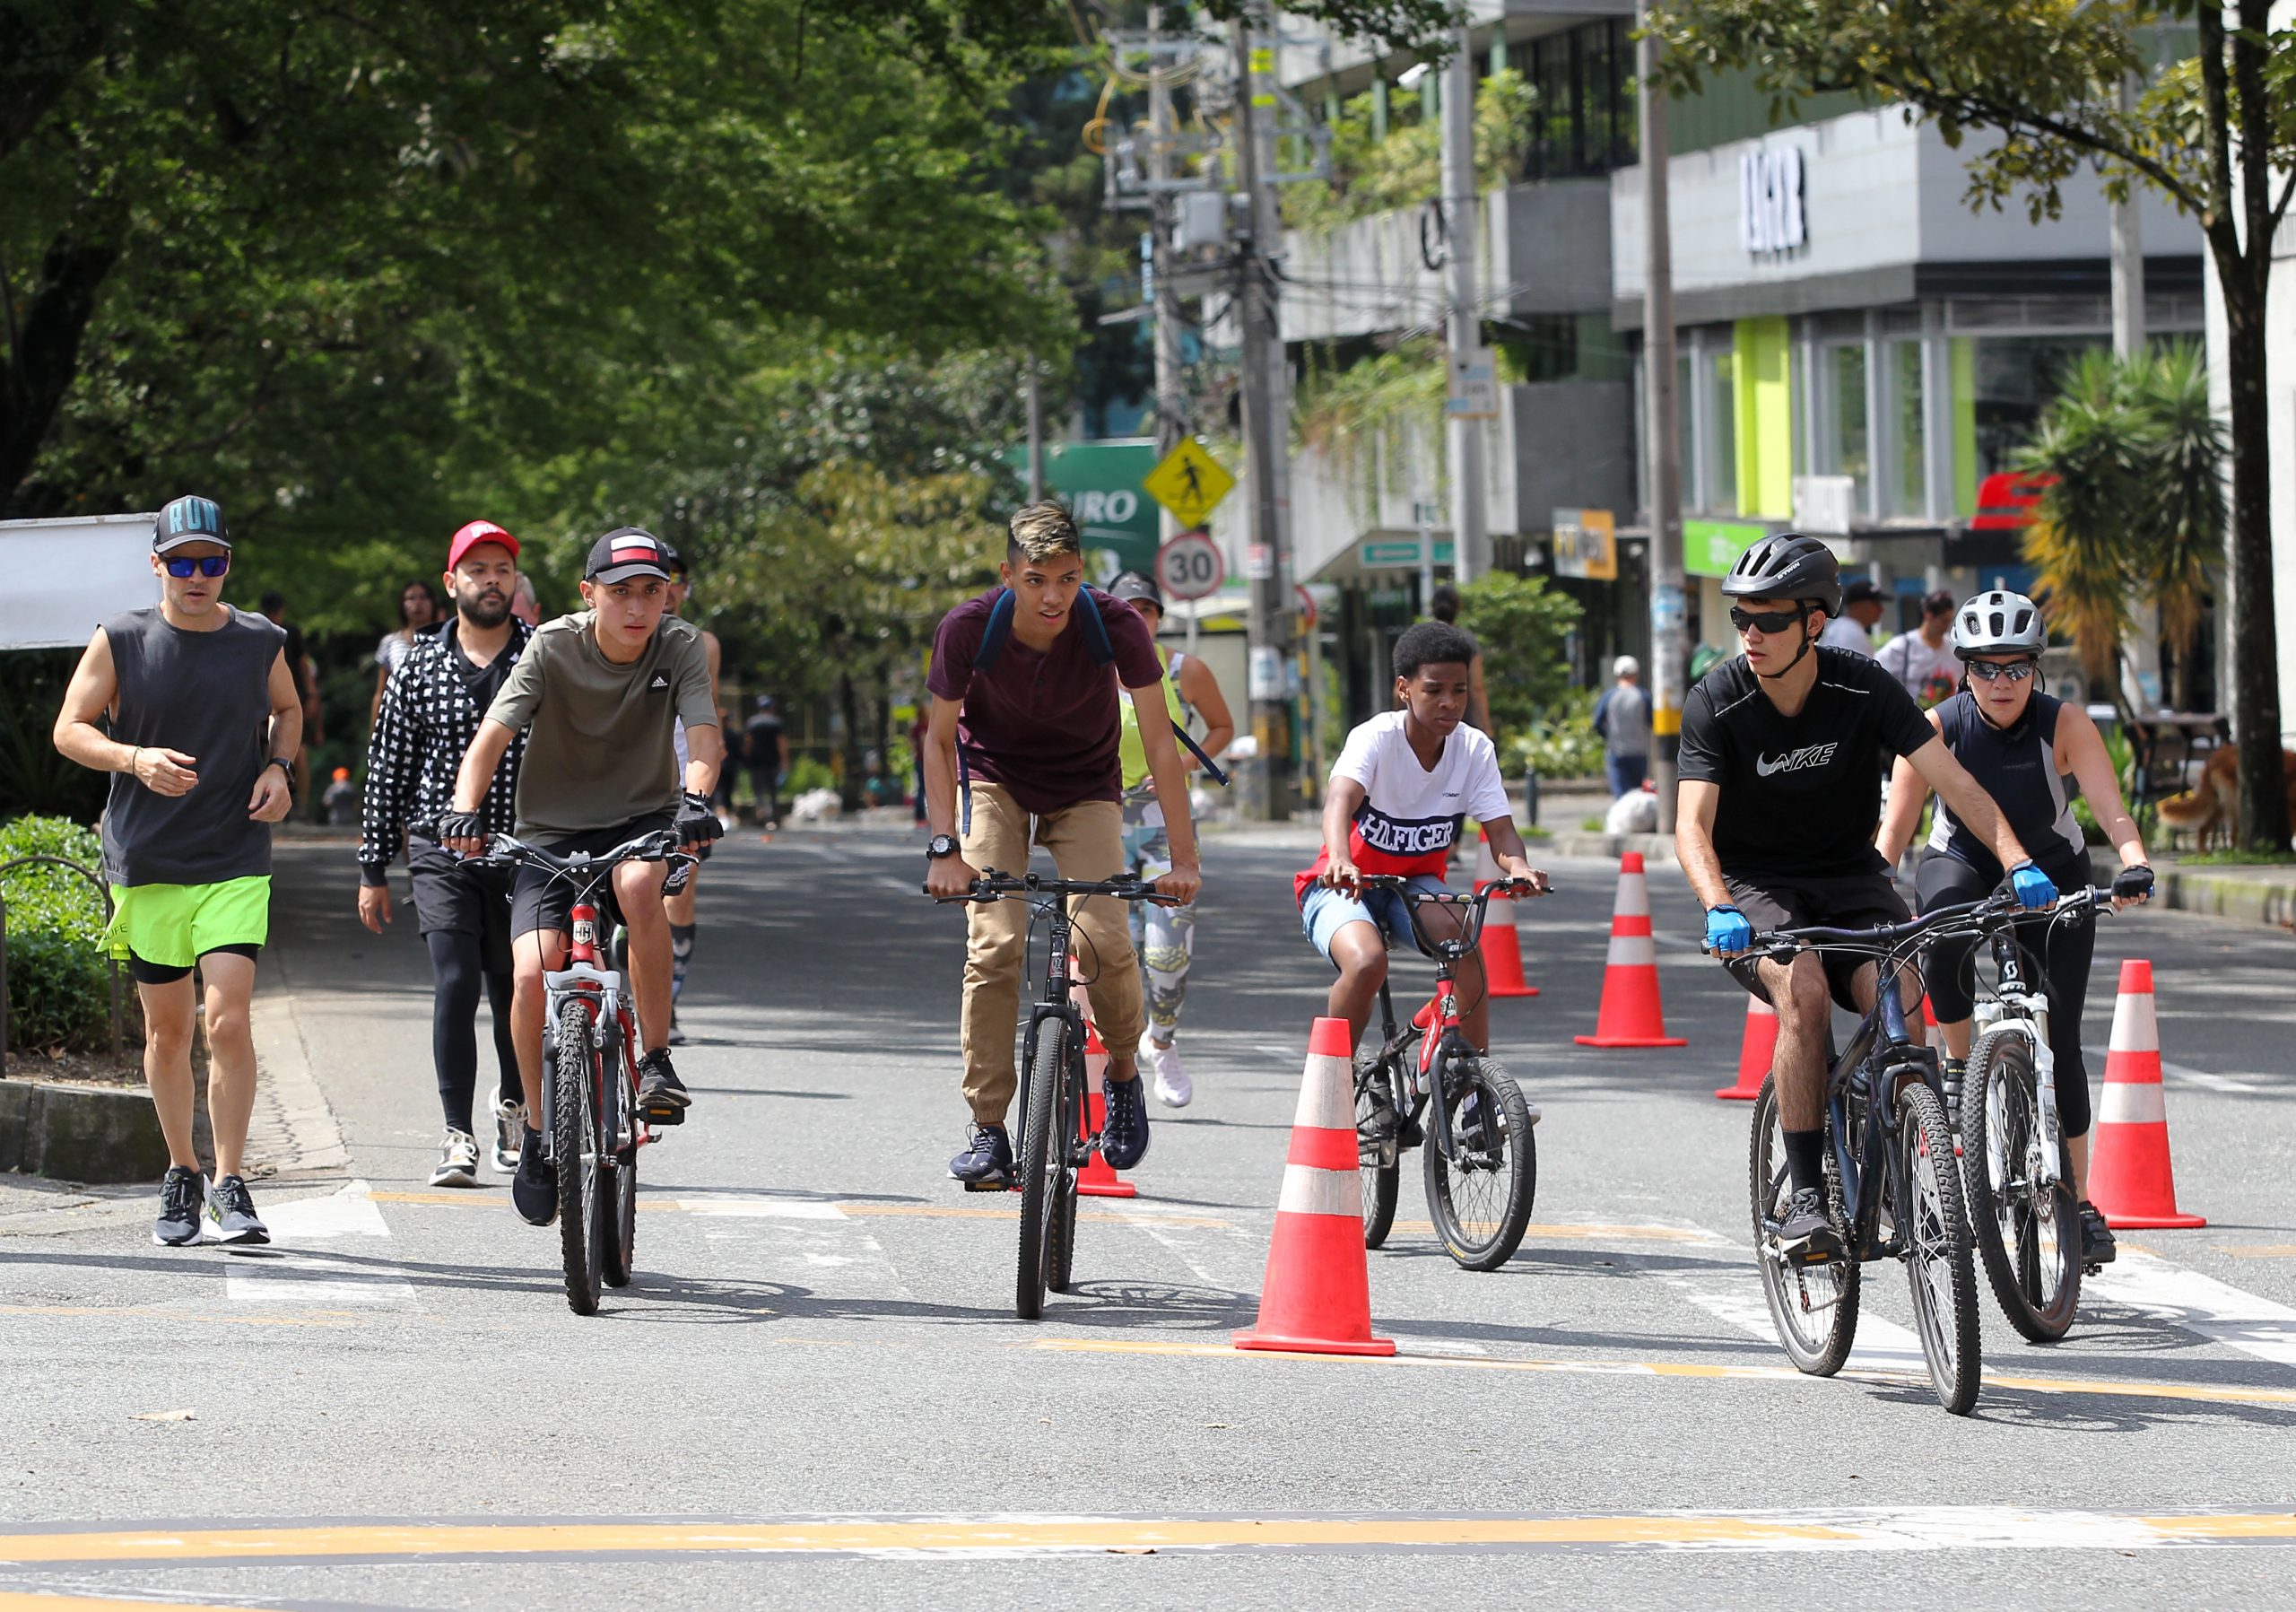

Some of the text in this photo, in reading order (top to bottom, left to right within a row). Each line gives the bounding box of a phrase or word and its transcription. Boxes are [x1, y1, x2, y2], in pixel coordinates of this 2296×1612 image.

[169, 498, 217, 534] RUN
[1168, 549, 1213, 585] 30
[1768, 742, 1839, 772] NIKE
[1358, 813, 1454, 852] HILFIGER
